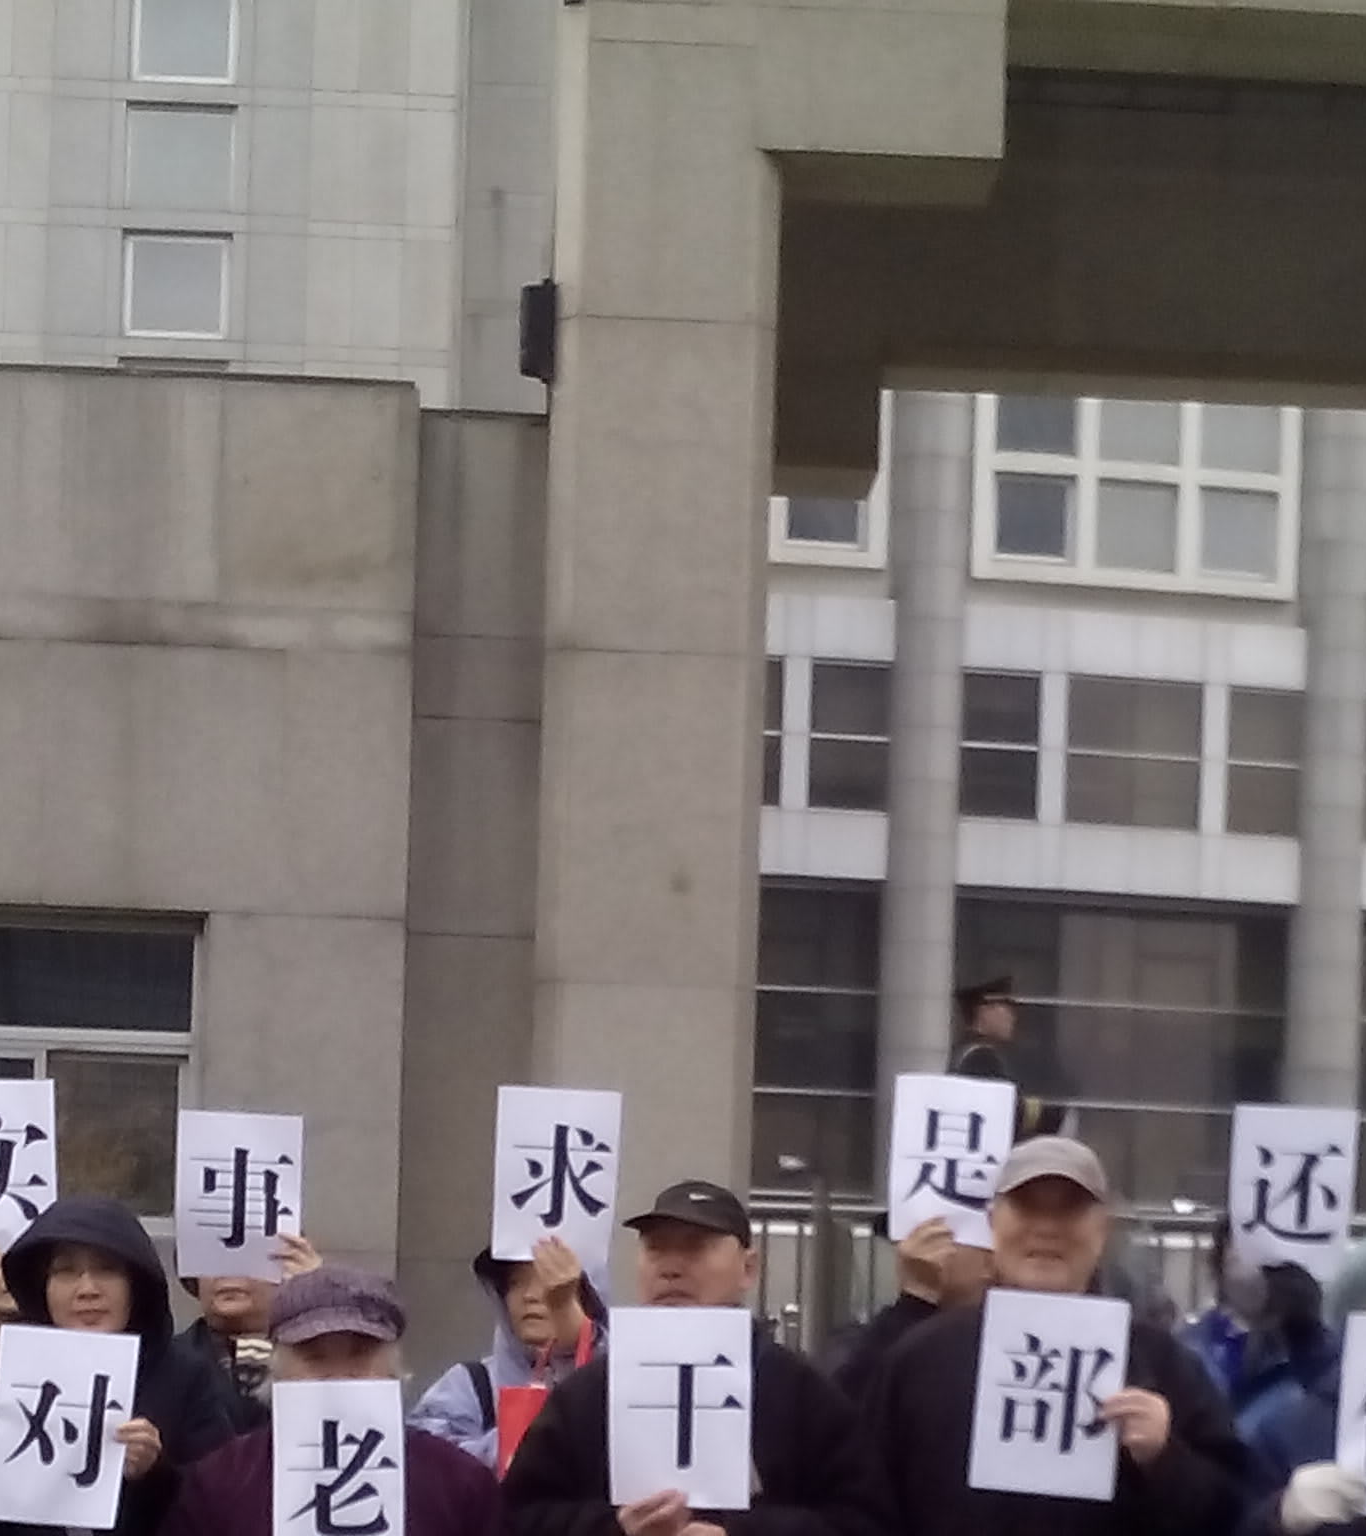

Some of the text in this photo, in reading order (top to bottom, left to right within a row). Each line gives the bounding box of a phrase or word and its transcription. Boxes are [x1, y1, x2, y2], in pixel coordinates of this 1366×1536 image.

[189, 1147, 293, 1249] 事
[512, 1123, 613, 1227] 求
[906, 1107, 1001, 1209] 是
[1241, 1144, 1344, 1243] 还
[5, 1373, 124, 1488] 对
[628, 1353, 745, 1469] 干
[997, 1332, 1114, 1454] 部
